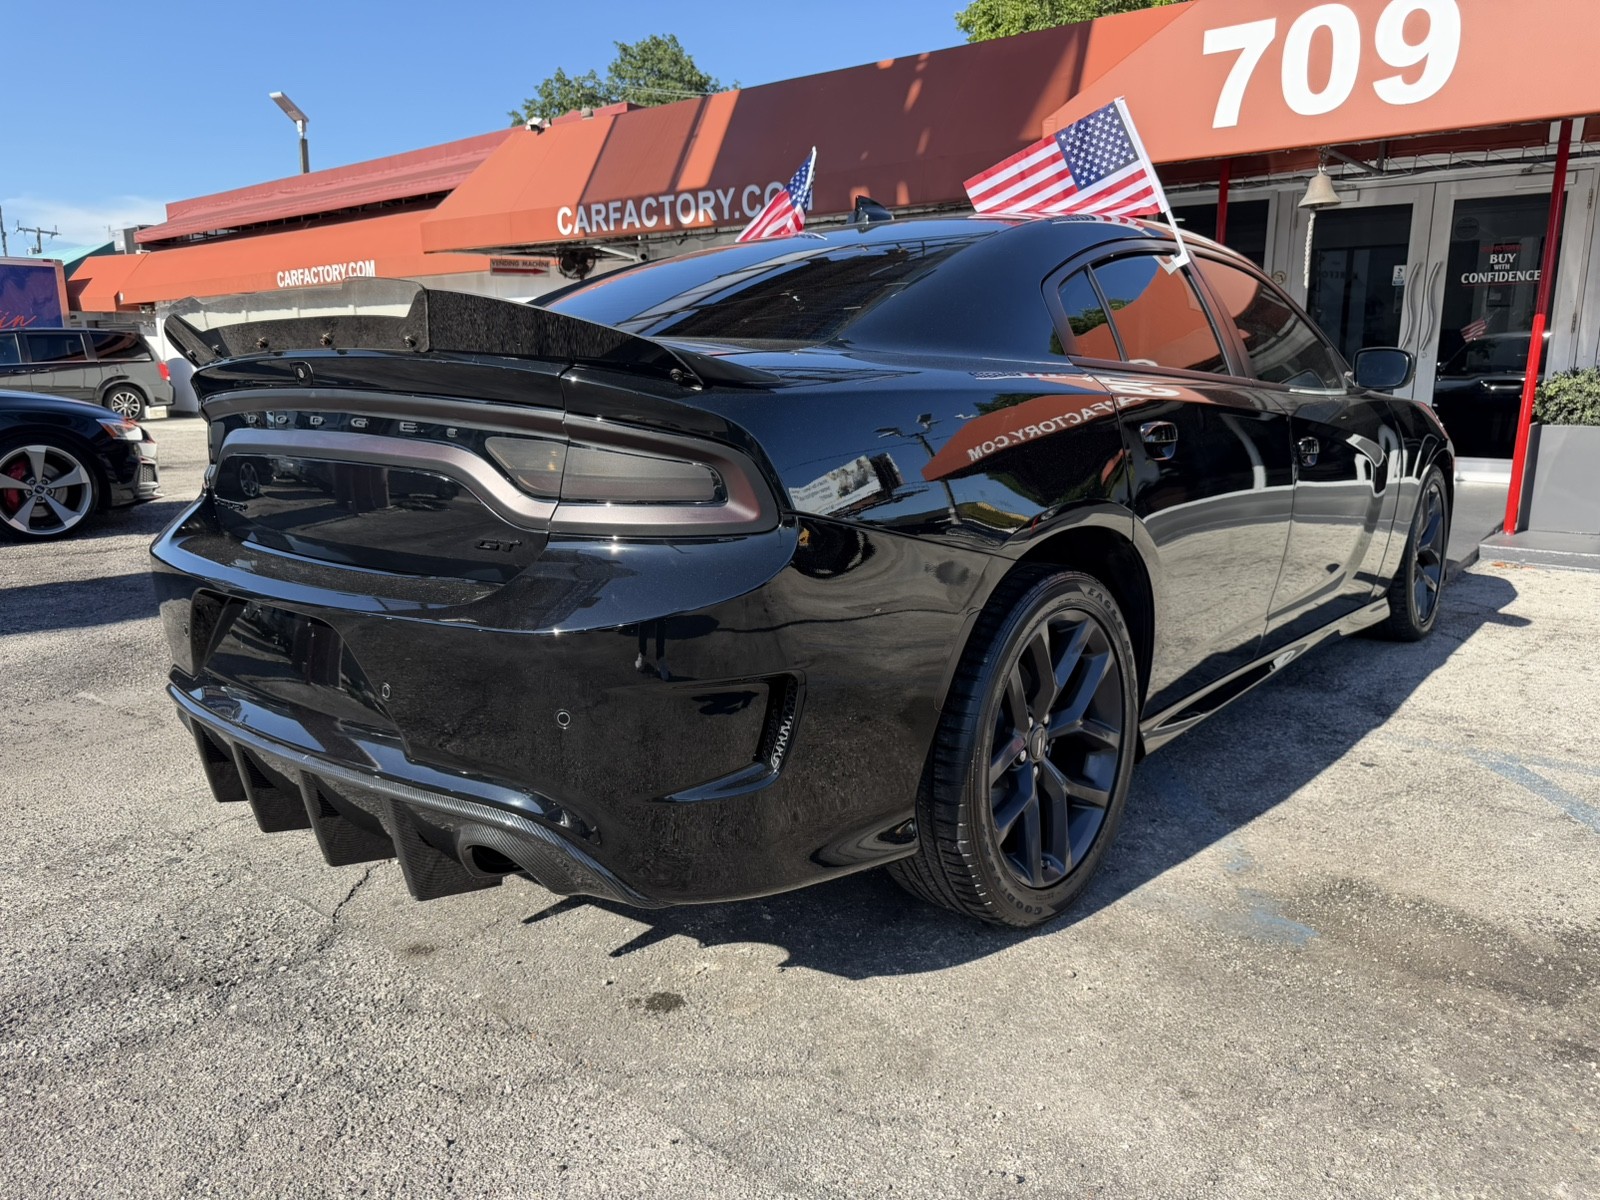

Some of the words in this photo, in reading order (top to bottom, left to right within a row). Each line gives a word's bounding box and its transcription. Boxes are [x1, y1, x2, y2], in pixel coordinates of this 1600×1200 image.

[1203, 0, 1461, 128] 709
[557, 181, 813, 236] CARFACTORY.CO
[1490, 253, 1516, 264] BUY
[277, 260, 375, 287] CARFACTORY.COM
[1461, 270, 1541, 283] CONFIDENCE
[246, 414, 418, 434] DODGE
[477, 539, 523, 552] GT
